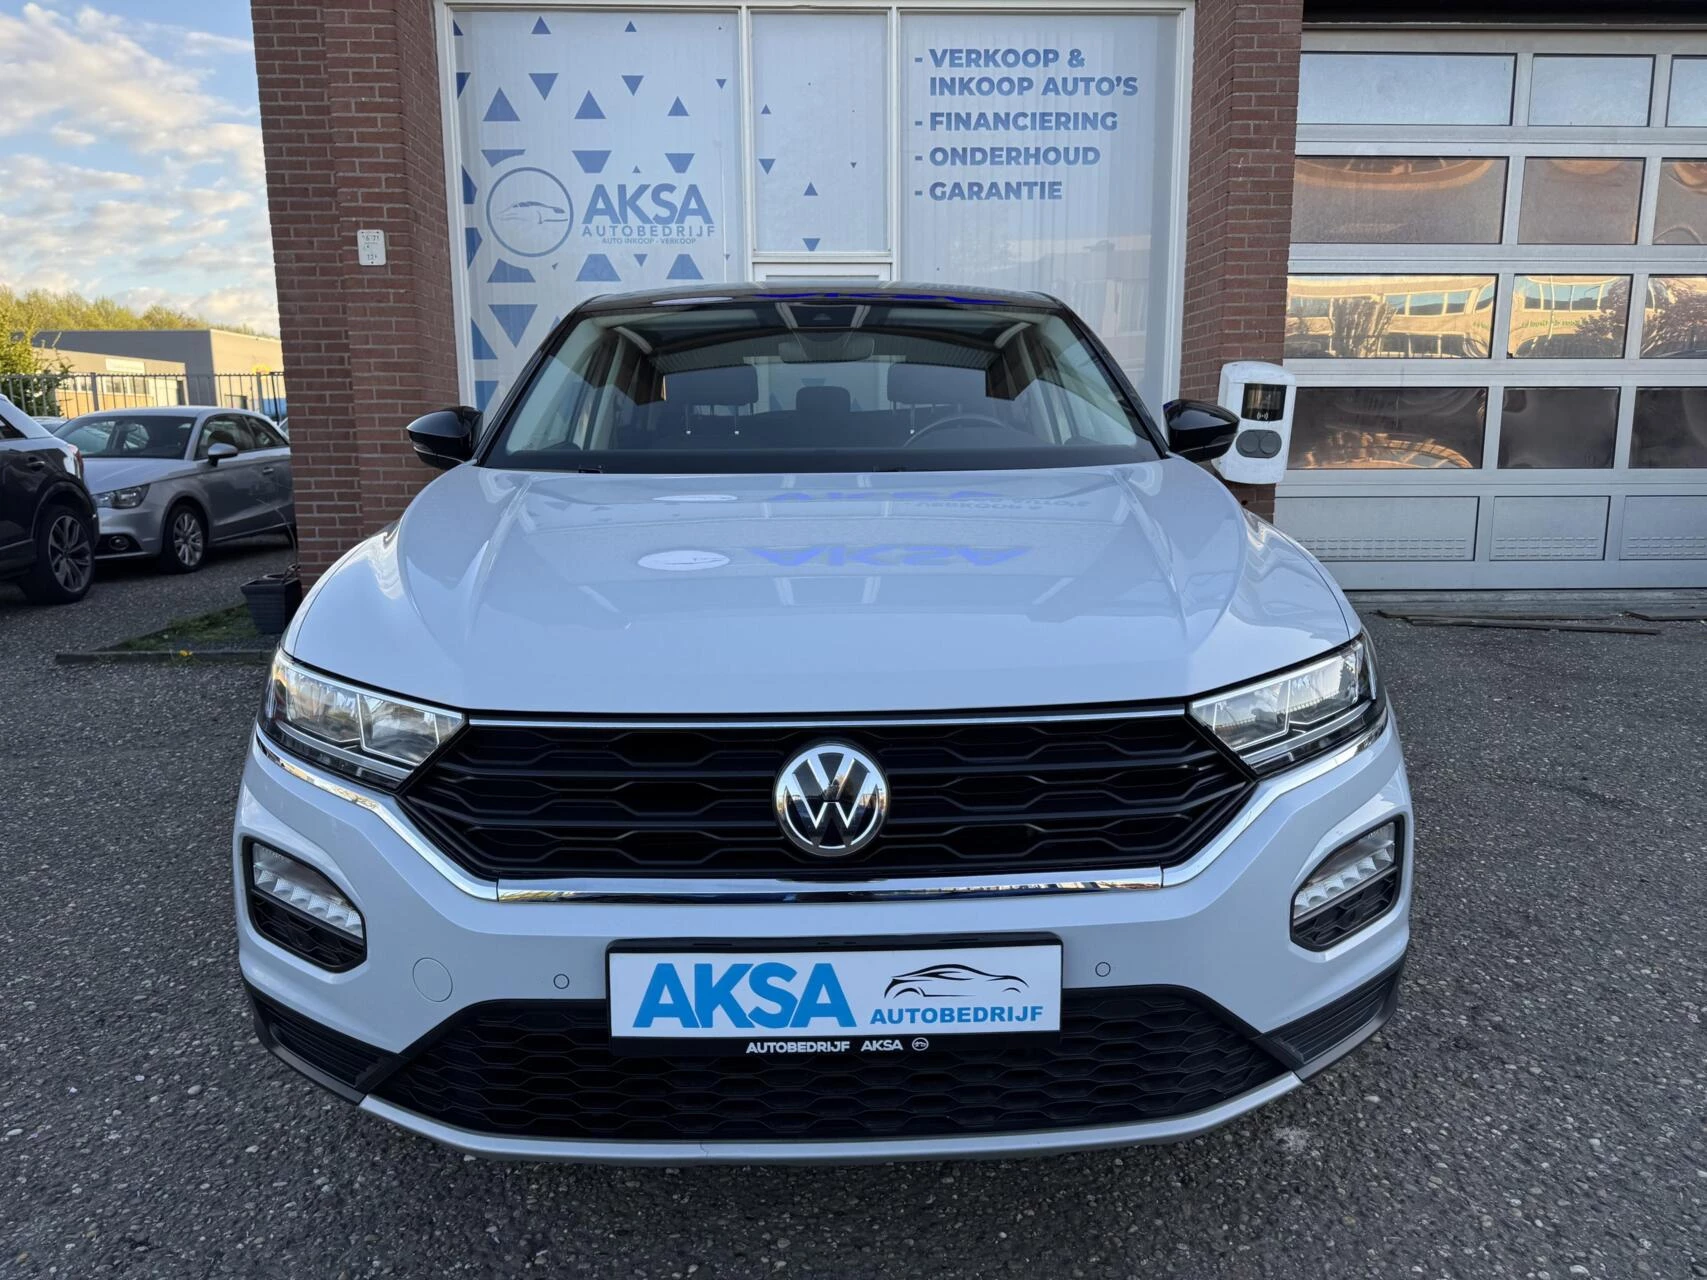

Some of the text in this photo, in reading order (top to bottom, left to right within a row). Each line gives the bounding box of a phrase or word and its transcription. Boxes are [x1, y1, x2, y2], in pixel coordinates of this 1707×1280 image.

[929, 49, 1060, 68] VERKOOP
[1068, 49, 1085, 68] &
[929, 76, 1138, 96] INKOOP AUTO'S
[929, 112, 1118, 131] FINANCIERING
[929, 147, 1100, 166] ONDERHOUD
[929, 181, 1062, 201] GARANTIE
[582, 183, 714, 225] AKSA
[582, 226, 715, 237] AUTOBEDRIJF
[632, 961, 856, 1029] AKSA
[869, 1005, 1044, 1025] AUTOBEDRIJF
[745, 1039, 903, 1054] AUTOBEDRIJF AKSA
